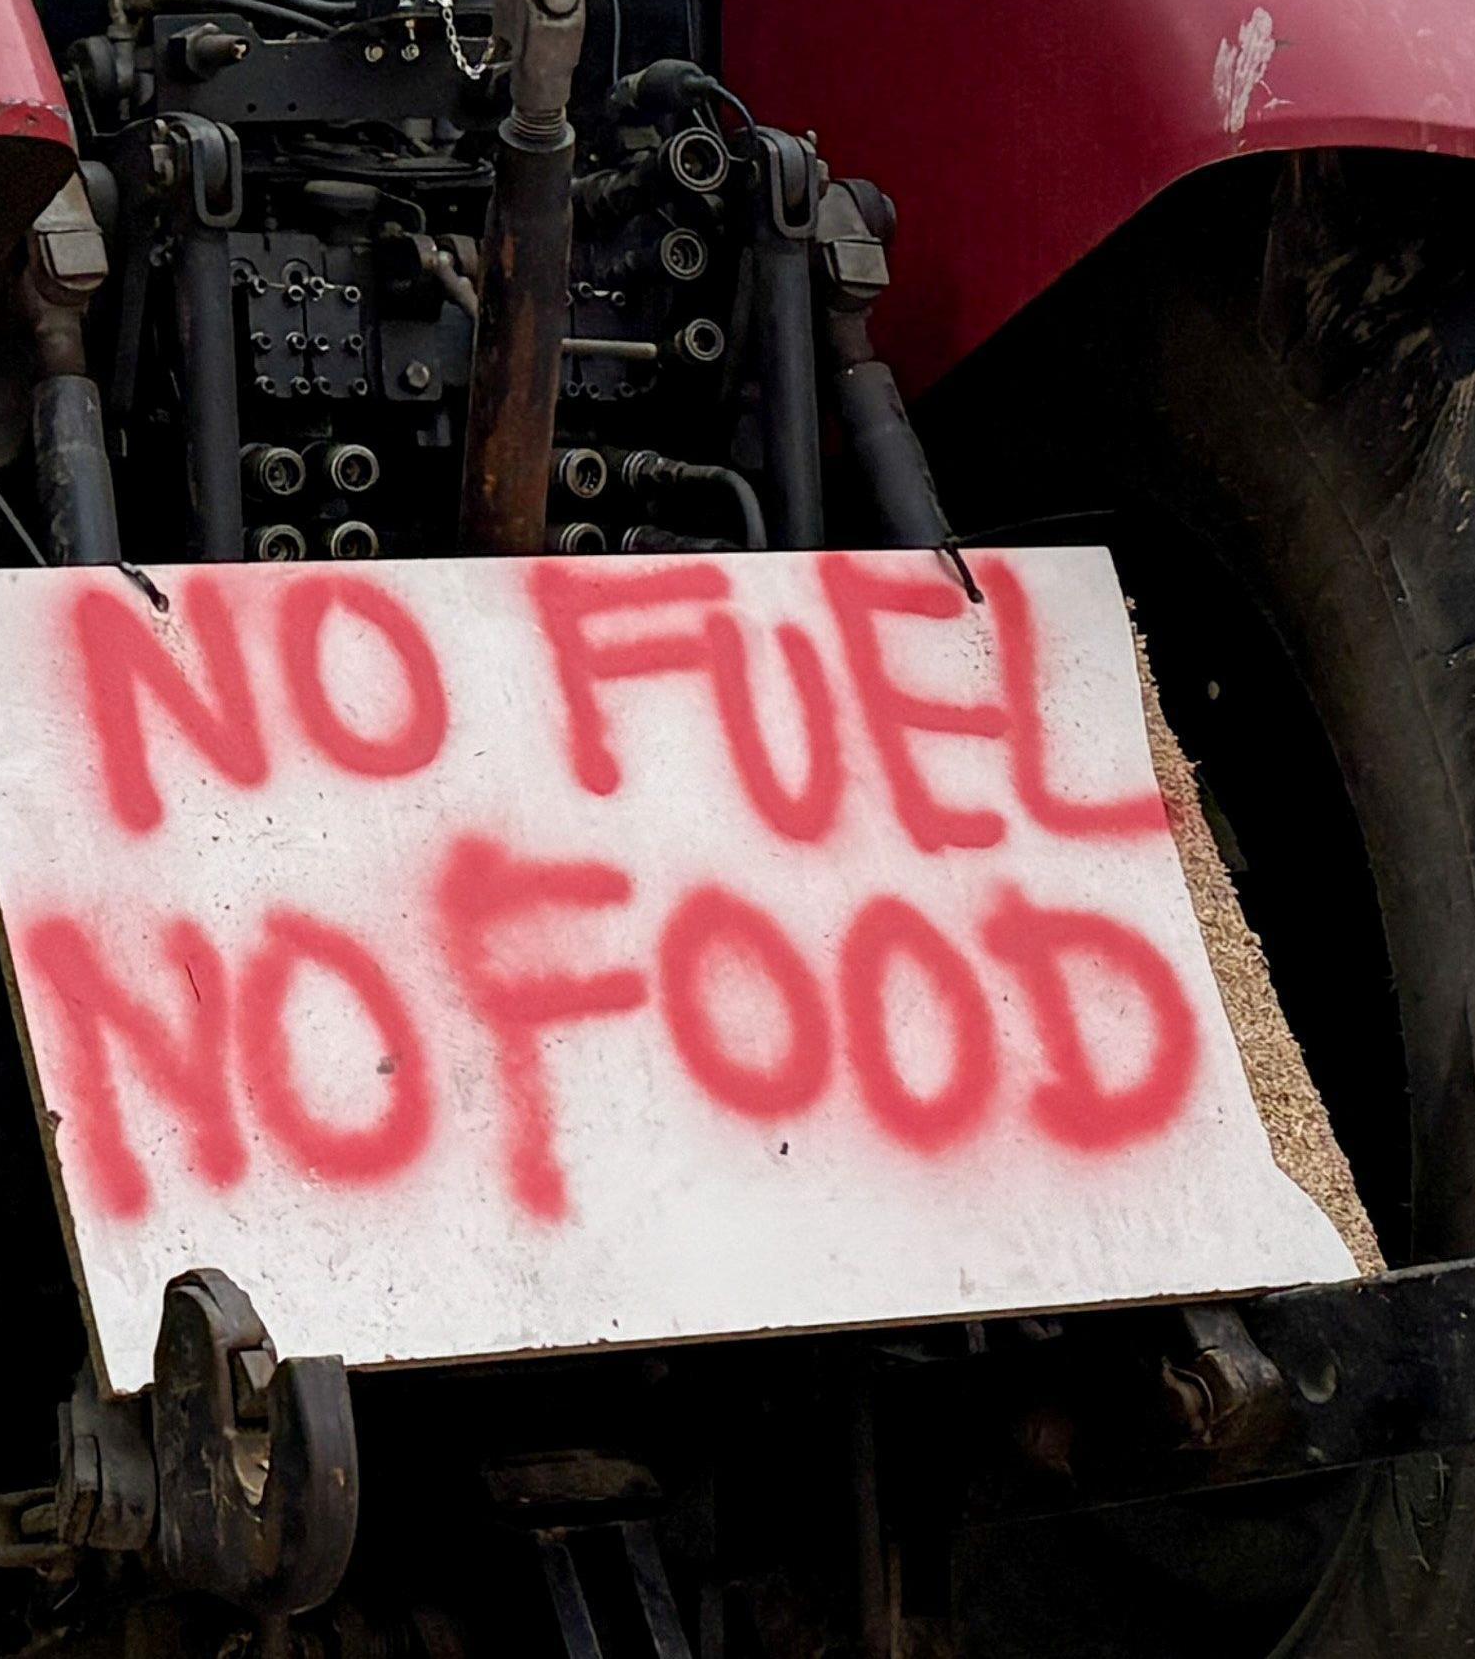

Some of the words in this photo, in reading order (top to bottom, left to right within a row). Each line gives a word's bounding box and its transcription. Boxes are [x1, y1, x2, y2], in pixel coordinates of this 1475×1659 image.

[68, 570, 450, 834] NO
[525, 552, 1172, 852] FUEL
[22, 908, 437, 1222] NO
[438, 832, 1200, 1225] FOOD
